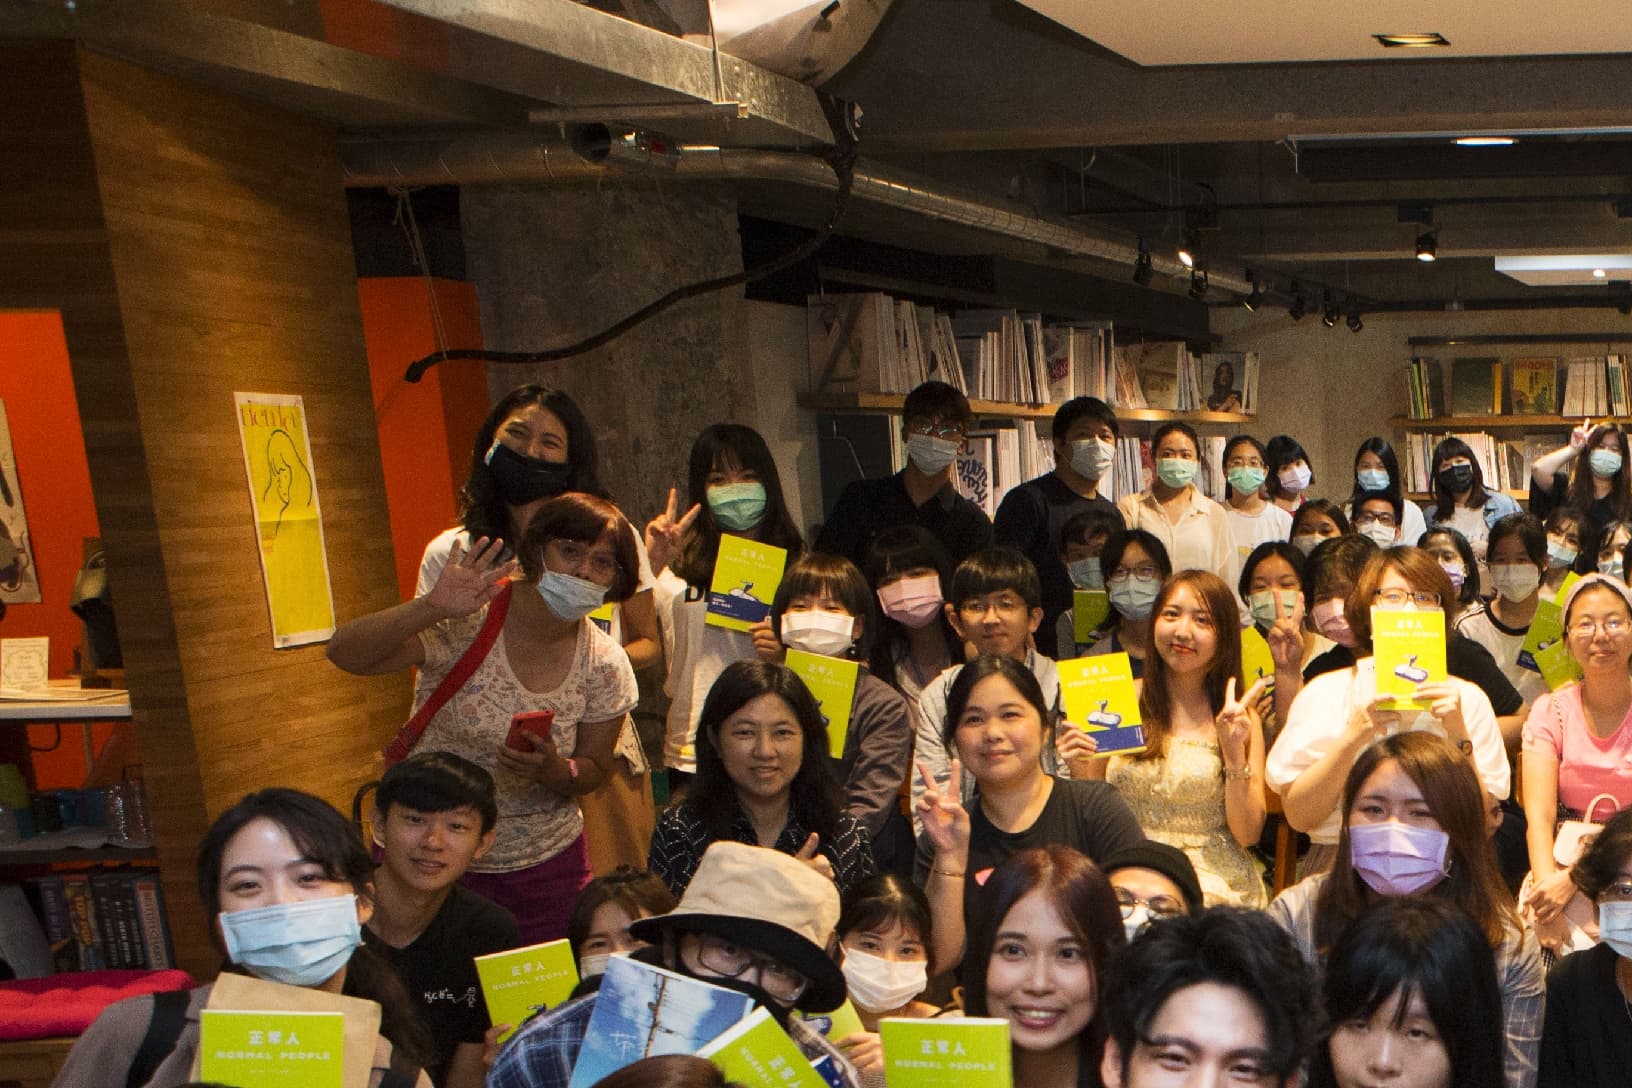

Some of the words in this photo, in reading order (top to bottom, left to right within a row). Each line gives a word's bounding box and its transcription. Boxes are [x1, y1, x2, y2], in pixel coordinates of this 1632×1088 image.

[248, 1030, 300, 1046] 正常人
[920, 1039, 967, 1056] 正常人
[215, 1051, 272, 1060] NORMAL
[280, 1052, 331, 1061] PEOPLE
[894, 1059, 942, 1069] NORMAL
[948, 1061, 997, 1071] PEOPLE
